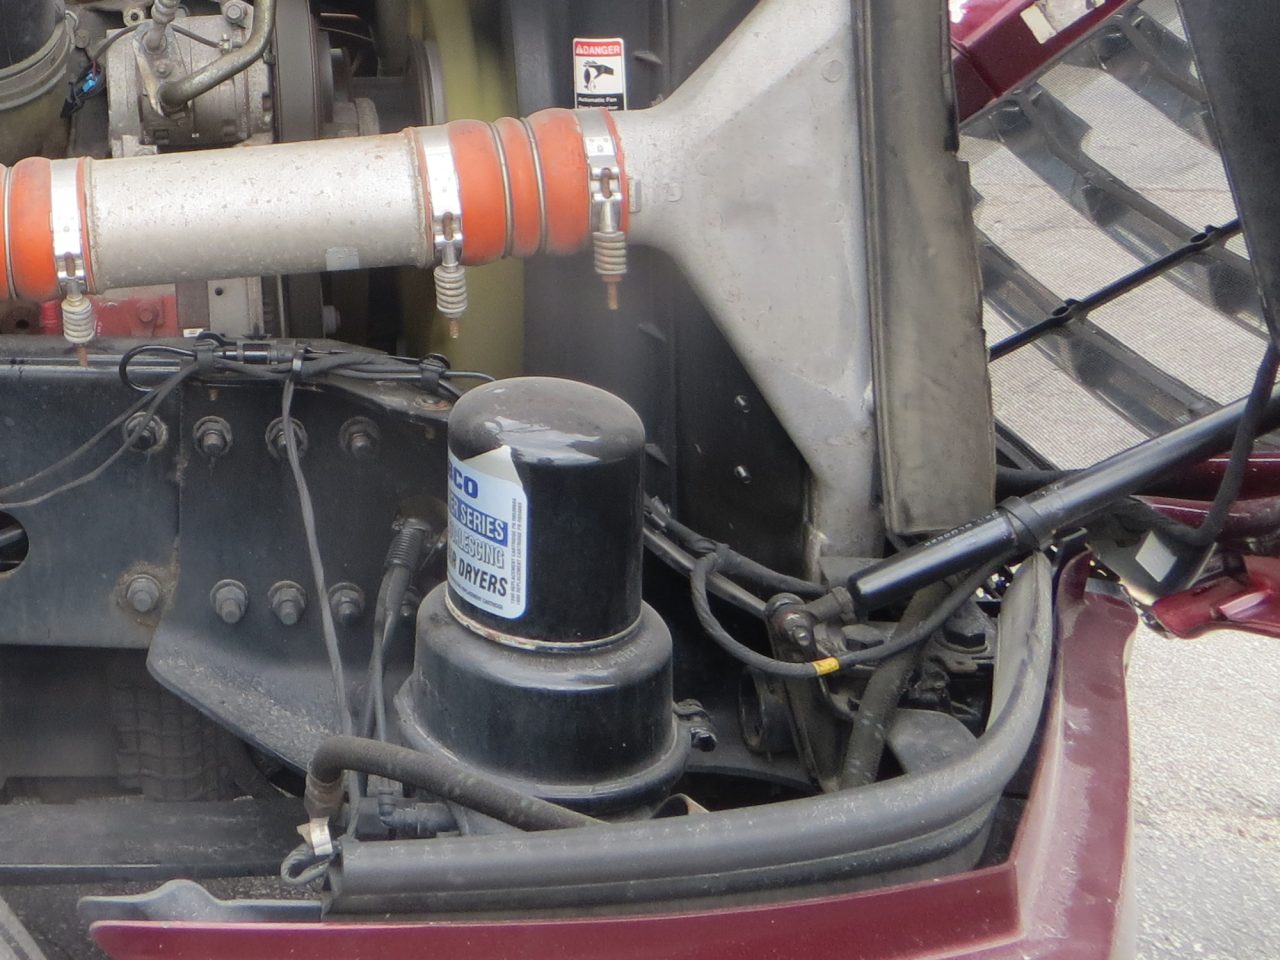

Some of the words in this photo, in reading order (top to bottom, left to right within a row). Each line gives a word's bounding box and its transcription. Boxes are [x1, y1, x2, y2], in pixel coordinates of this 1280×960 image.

[583, 45, 620, 55] DANGER
[460, 503, 505, 541] SERIES
[458, 558, 508, 597] DRYERS
